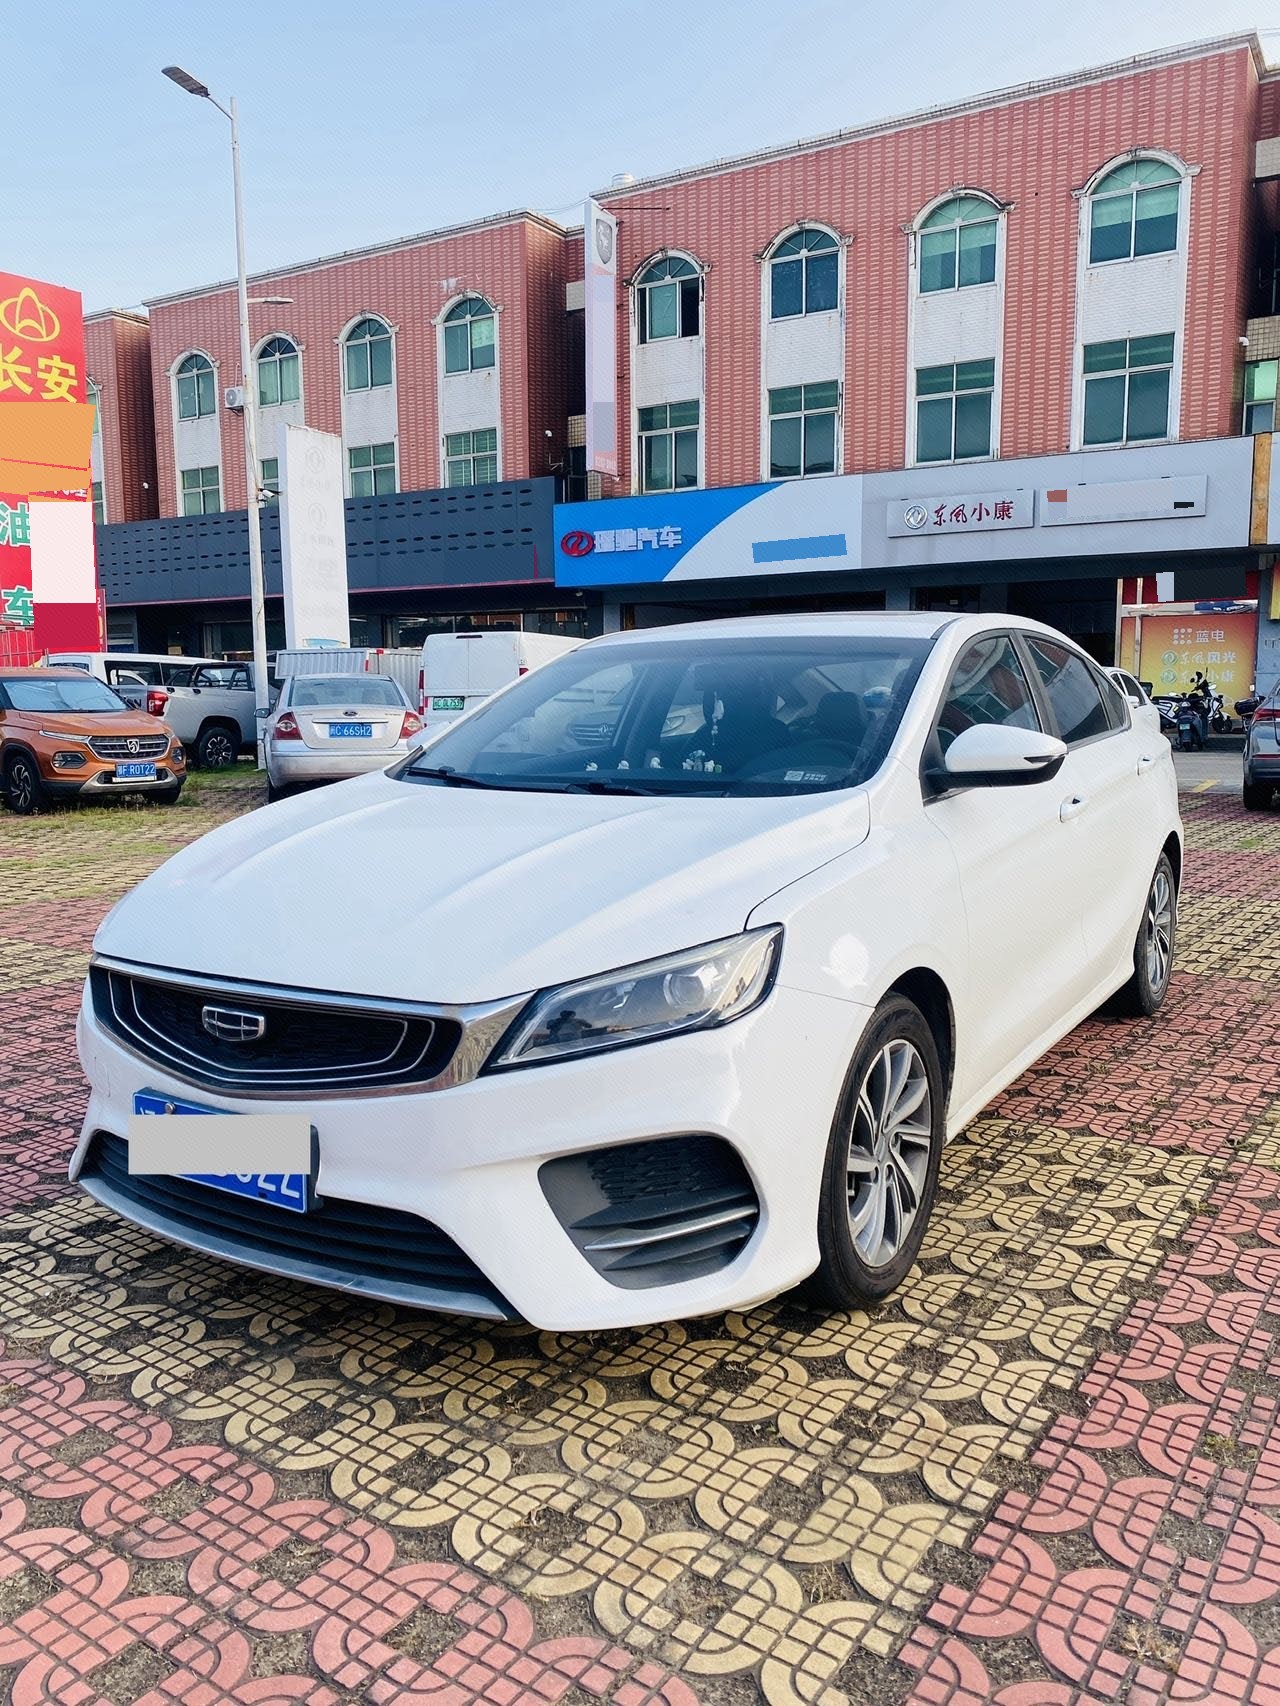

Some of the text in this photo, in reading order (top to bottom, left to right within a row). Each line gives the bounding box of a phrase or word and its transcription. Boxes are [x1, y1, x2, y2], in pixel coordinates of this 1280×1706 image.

[0, 343, 78, 403] 长安
[932, 500, 1014, 527] 东风小康
[1196, 629, 1225, 643] 蓝电
